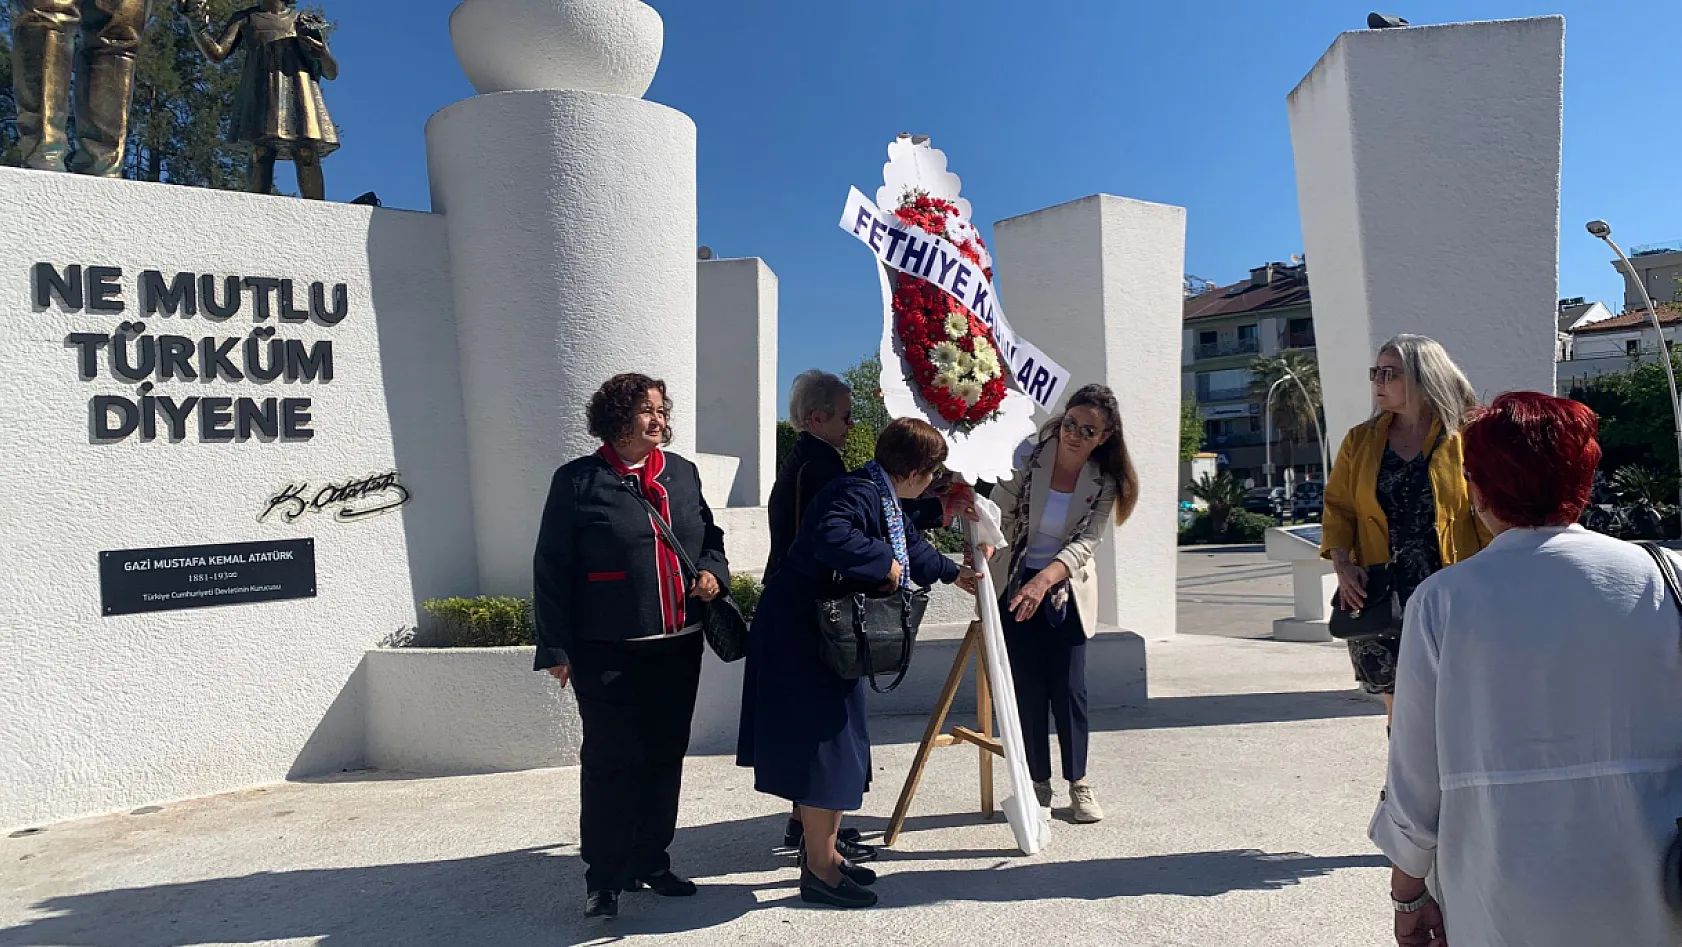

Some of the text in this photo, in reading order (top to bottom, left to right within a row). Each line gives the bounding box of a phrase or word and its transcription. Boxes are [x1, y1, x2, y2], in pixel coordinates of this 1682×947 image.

[853, 205, 972, 299] FETHİYE
[32, 262, 348, 326] NE MUTLU
[65, 320, 333, 384] TÜRKÜM
[89, 381, 315, 444] DİYENE
[123, 549, 294, 571] GAZİ MUSTAFA KEMAL ATATÜRK
[142, 583, 282, 602] Türkiye Cumhuriyeti Devletinin Kurucusu
